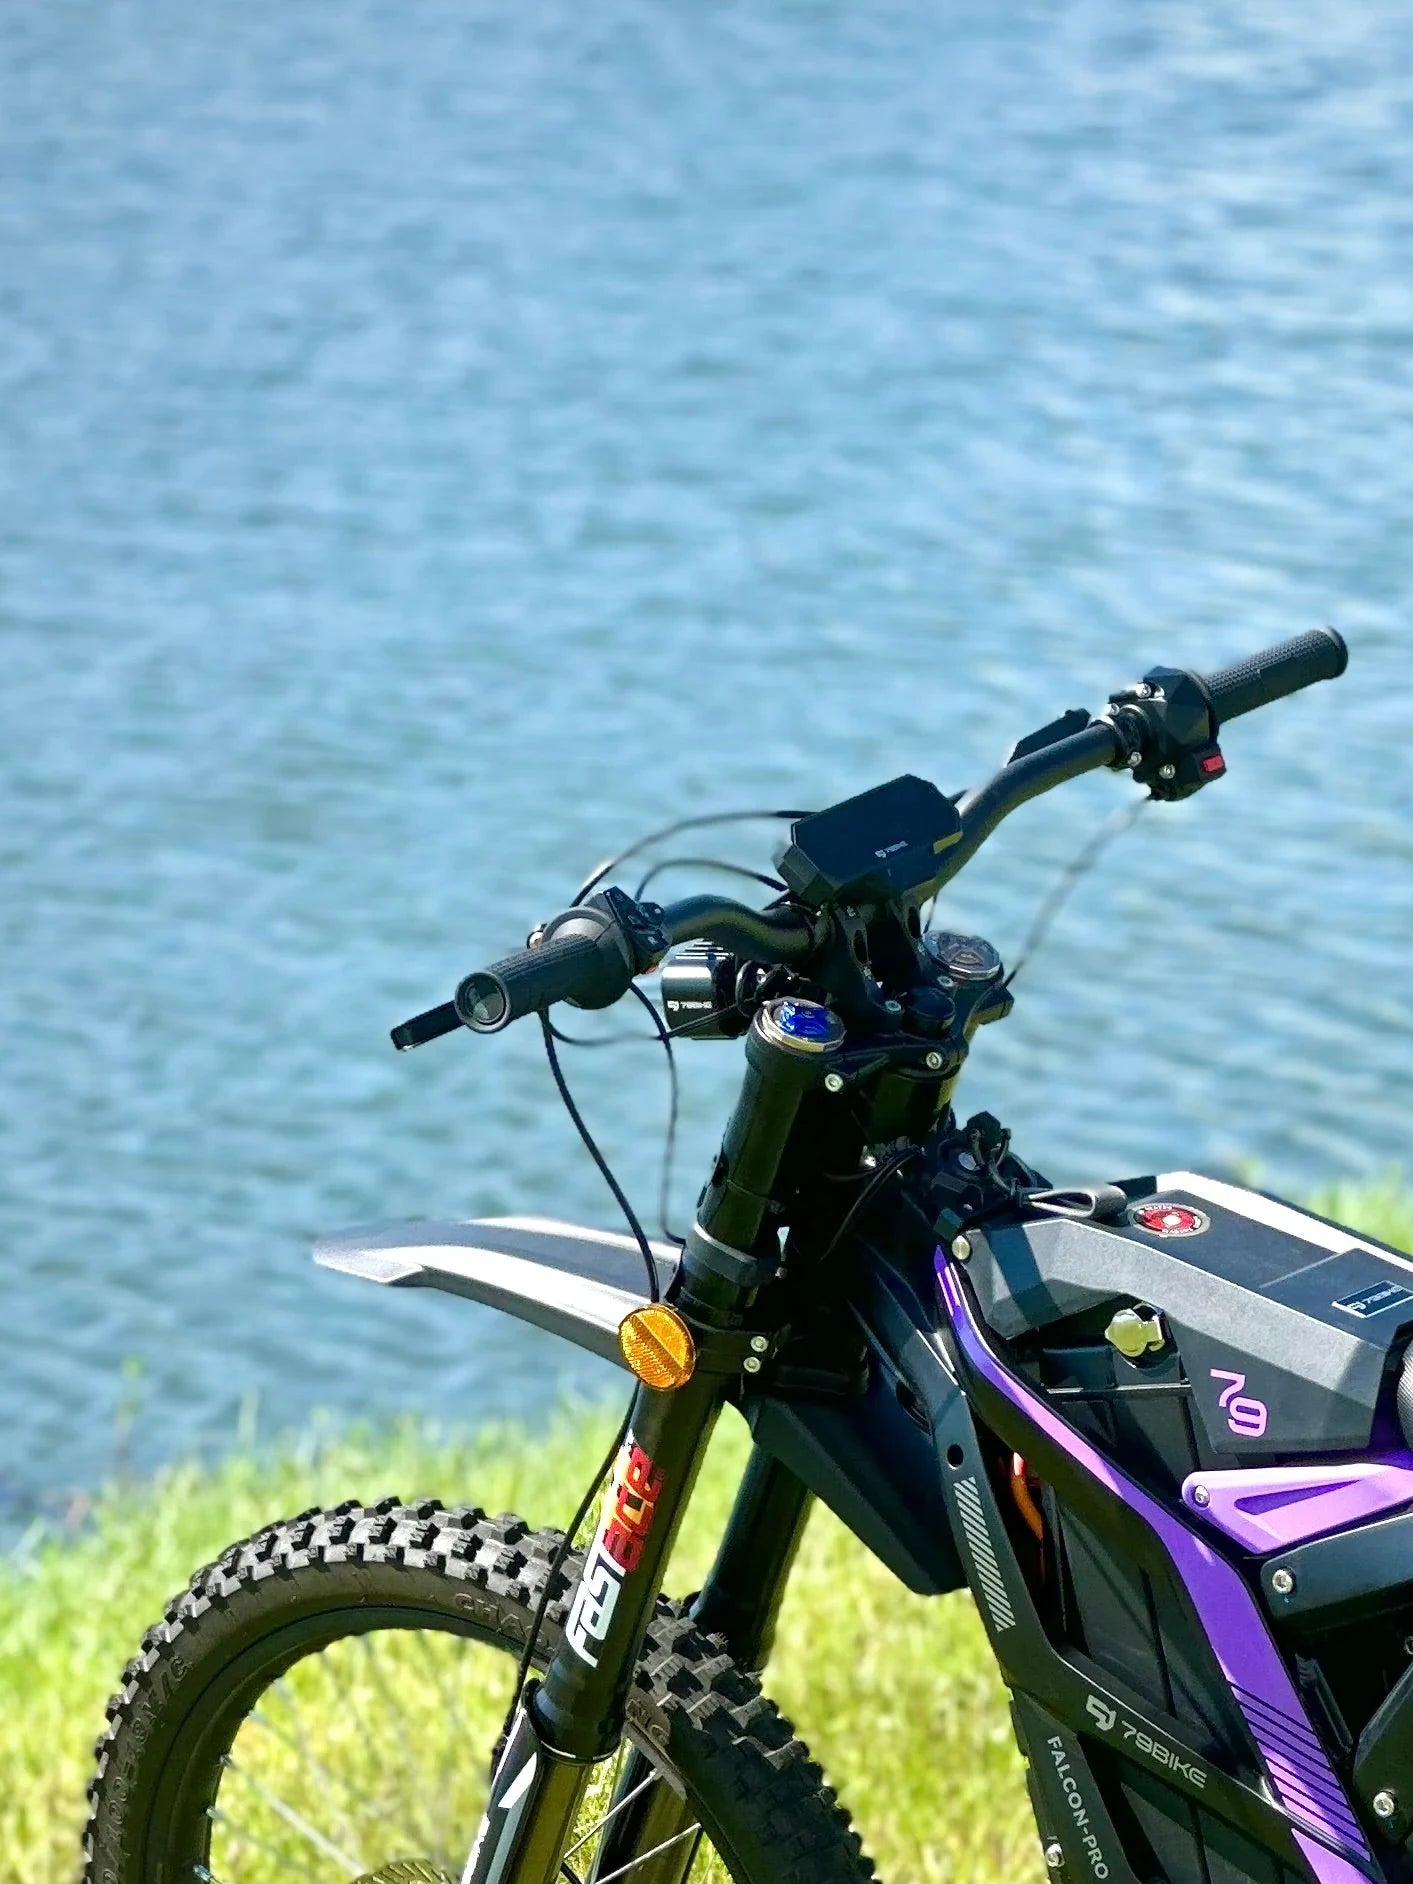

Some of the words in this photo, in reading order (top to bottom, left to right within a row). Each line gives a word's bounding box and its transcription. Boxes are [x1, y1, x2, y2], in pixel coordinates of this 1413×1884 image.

[1210, 1369, 1268, 1437] 79
[1121, 1720, 1207, 1789] 79BIKE
[1048, 1735, 1109, 1879] FALCON-PRO
